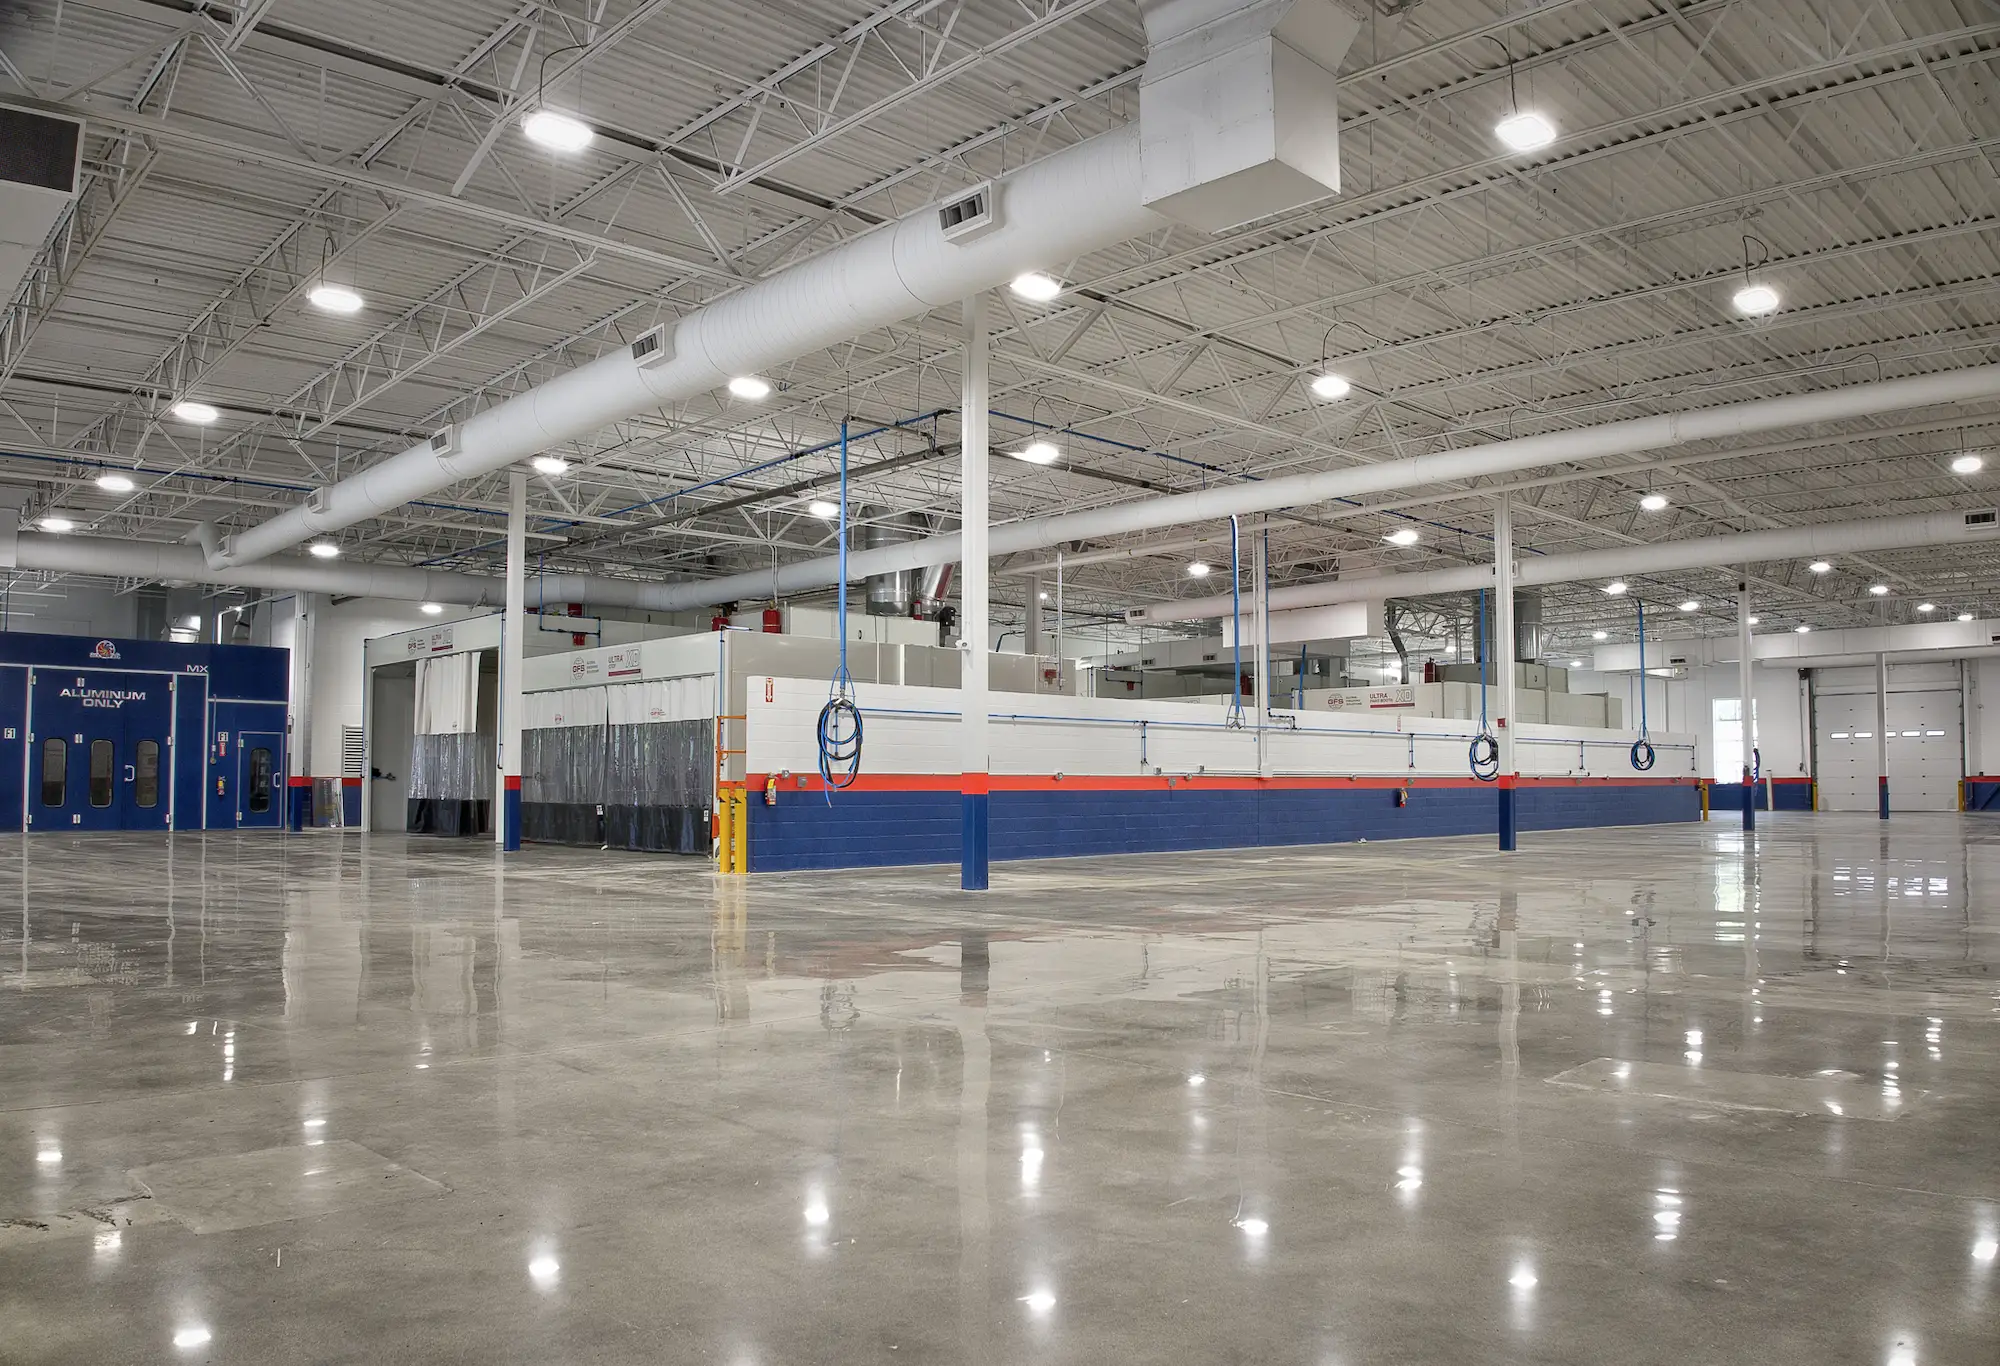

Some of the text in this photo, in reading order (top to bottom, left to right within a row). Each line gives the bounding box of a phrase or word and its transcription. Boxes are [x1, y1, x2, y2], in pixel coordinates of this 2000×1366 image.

[608, 655, 623, 663] ULTRA
[186, 665, 208, 673] MX
[573, 664, 585, 673] GFS
[60, 688, 146, 700] ALUMINUM
[1396, 689, 1413, 702] XD
[82, 698, 124, 709] ONLY
